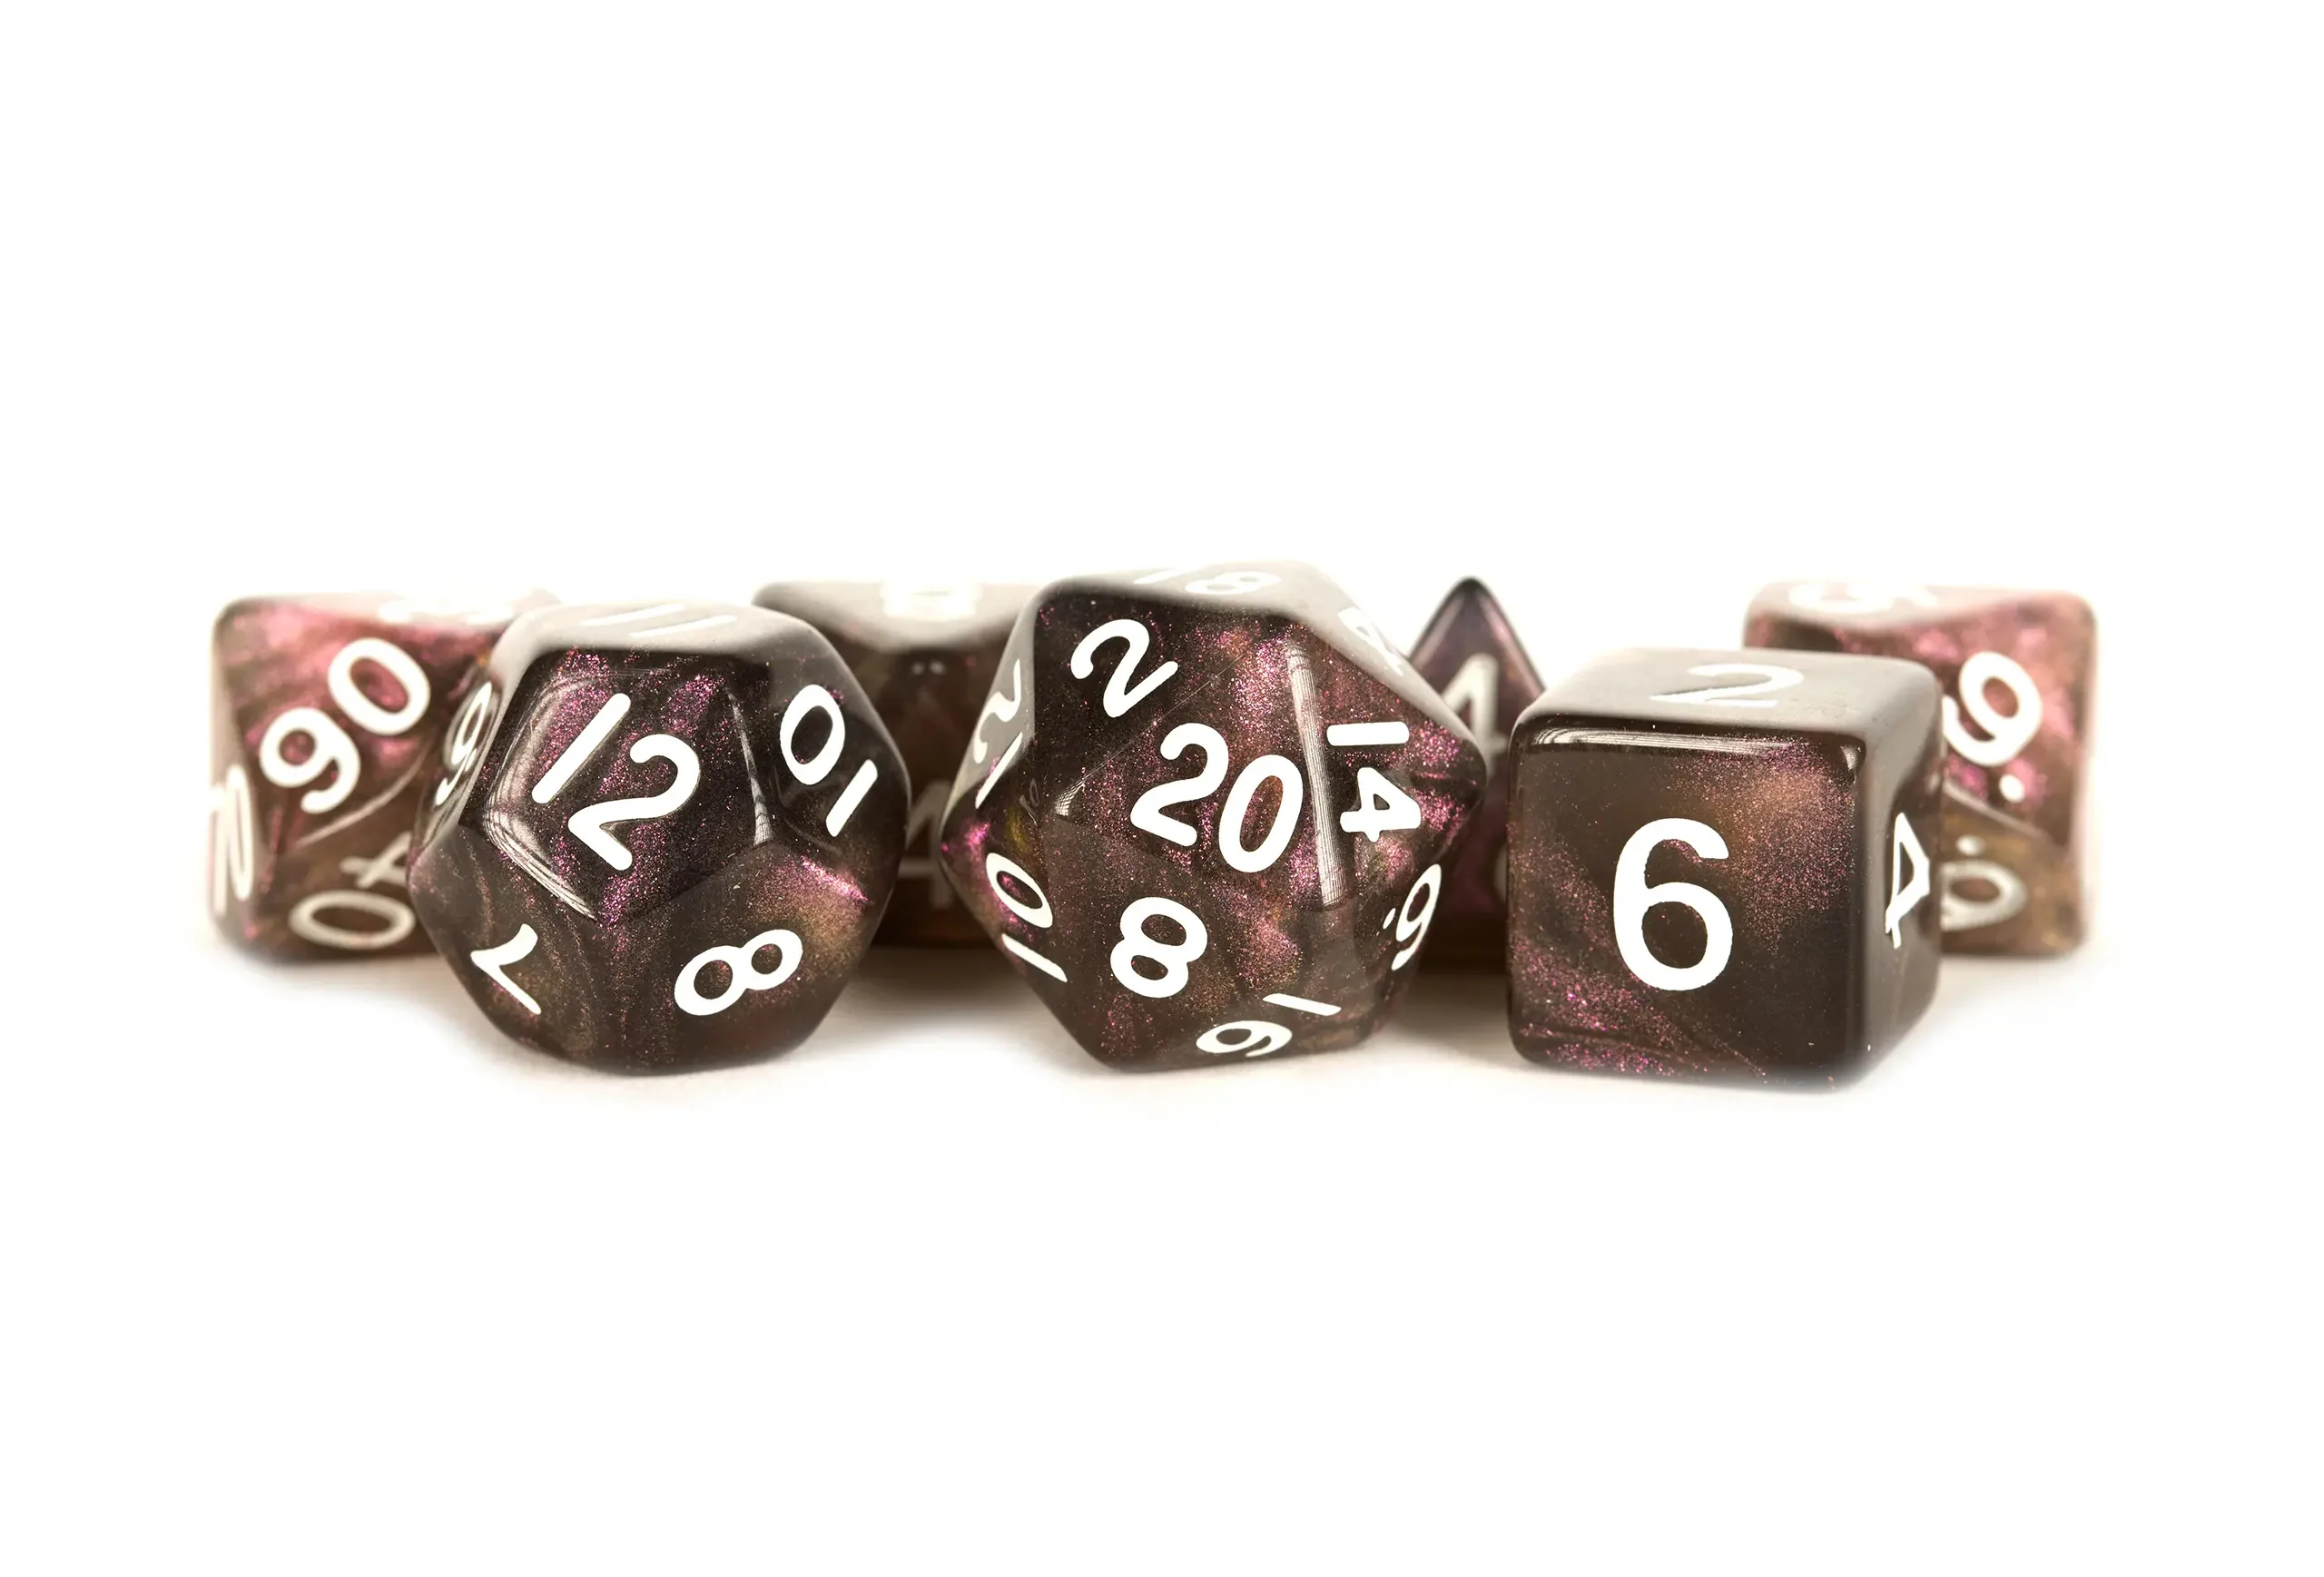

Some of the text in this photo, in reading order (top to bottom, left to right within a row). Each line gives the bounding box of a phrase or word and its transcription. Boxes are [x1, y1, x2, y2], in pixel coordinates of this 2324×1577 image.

[579, 602, 737, 638] 11
[1070, 618, 1178, 718] 2
[260, 637, 430, 813] 90
[1648, 663, 1805, 707] 2
[531, 693, 700, 871] 12
[779, 684, 878, 837] 10
[1130, 722, 1304, 872] 20
[1325, 721, 1423, 843] 14
[985, 853, 1068, 982] 10
[1612, 817, 1734, 991] 6
[1885, 812, 1930, 950] 4
[673, 929, 803, 1017] 8
[1109, 896, 1208, 999] 8
[1196, 992, 1342, 1057] 16
